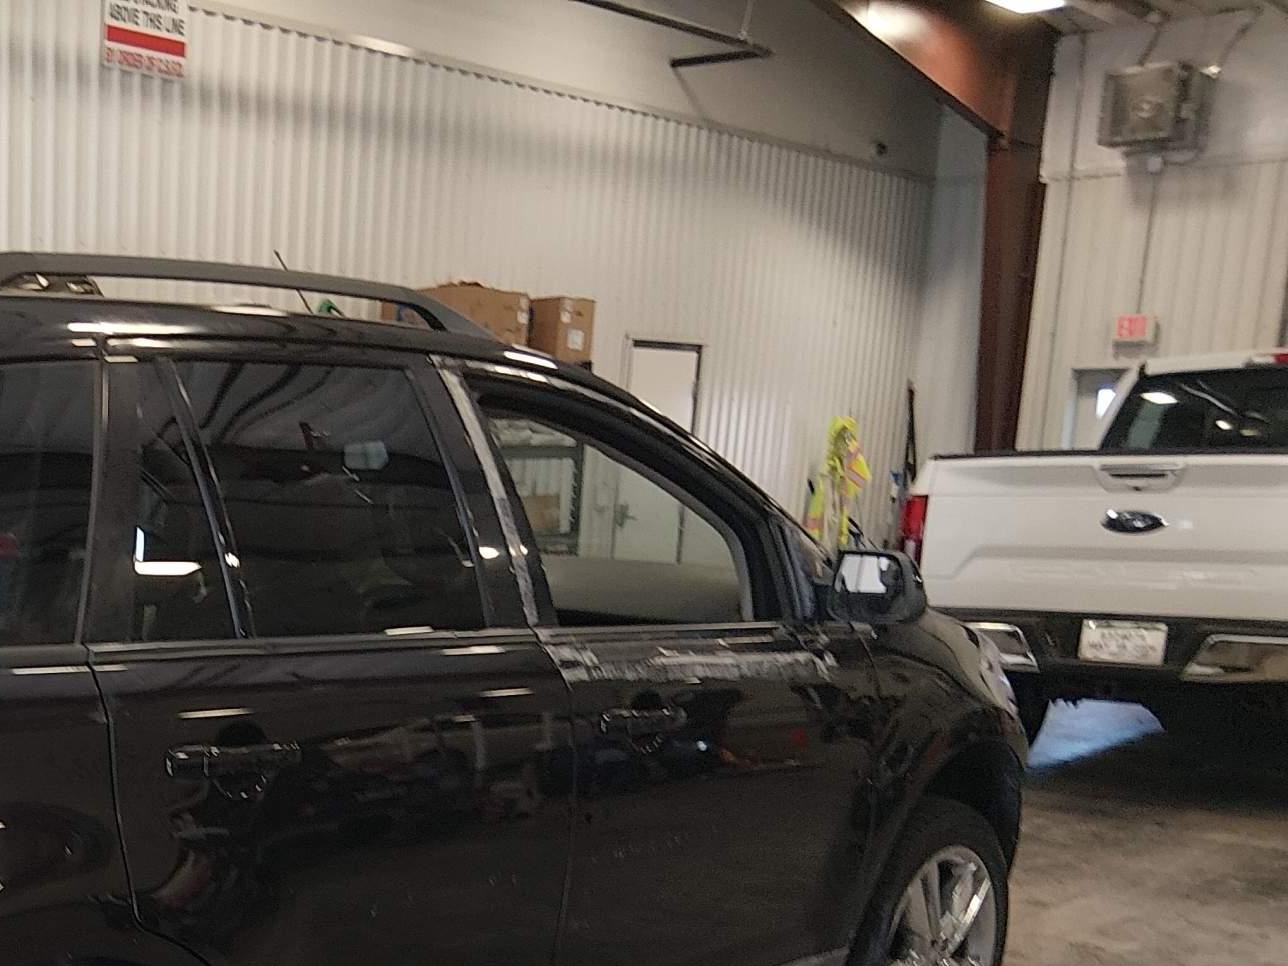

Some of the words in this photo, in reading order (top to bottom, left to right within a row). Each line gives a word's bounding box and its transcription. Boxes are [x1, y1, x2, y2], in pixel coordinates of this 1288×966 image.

[109, 2, 140, 26] ABOVE
[142, 10, 163, 32] THIS
[164, 15, 185, 37] LINE
